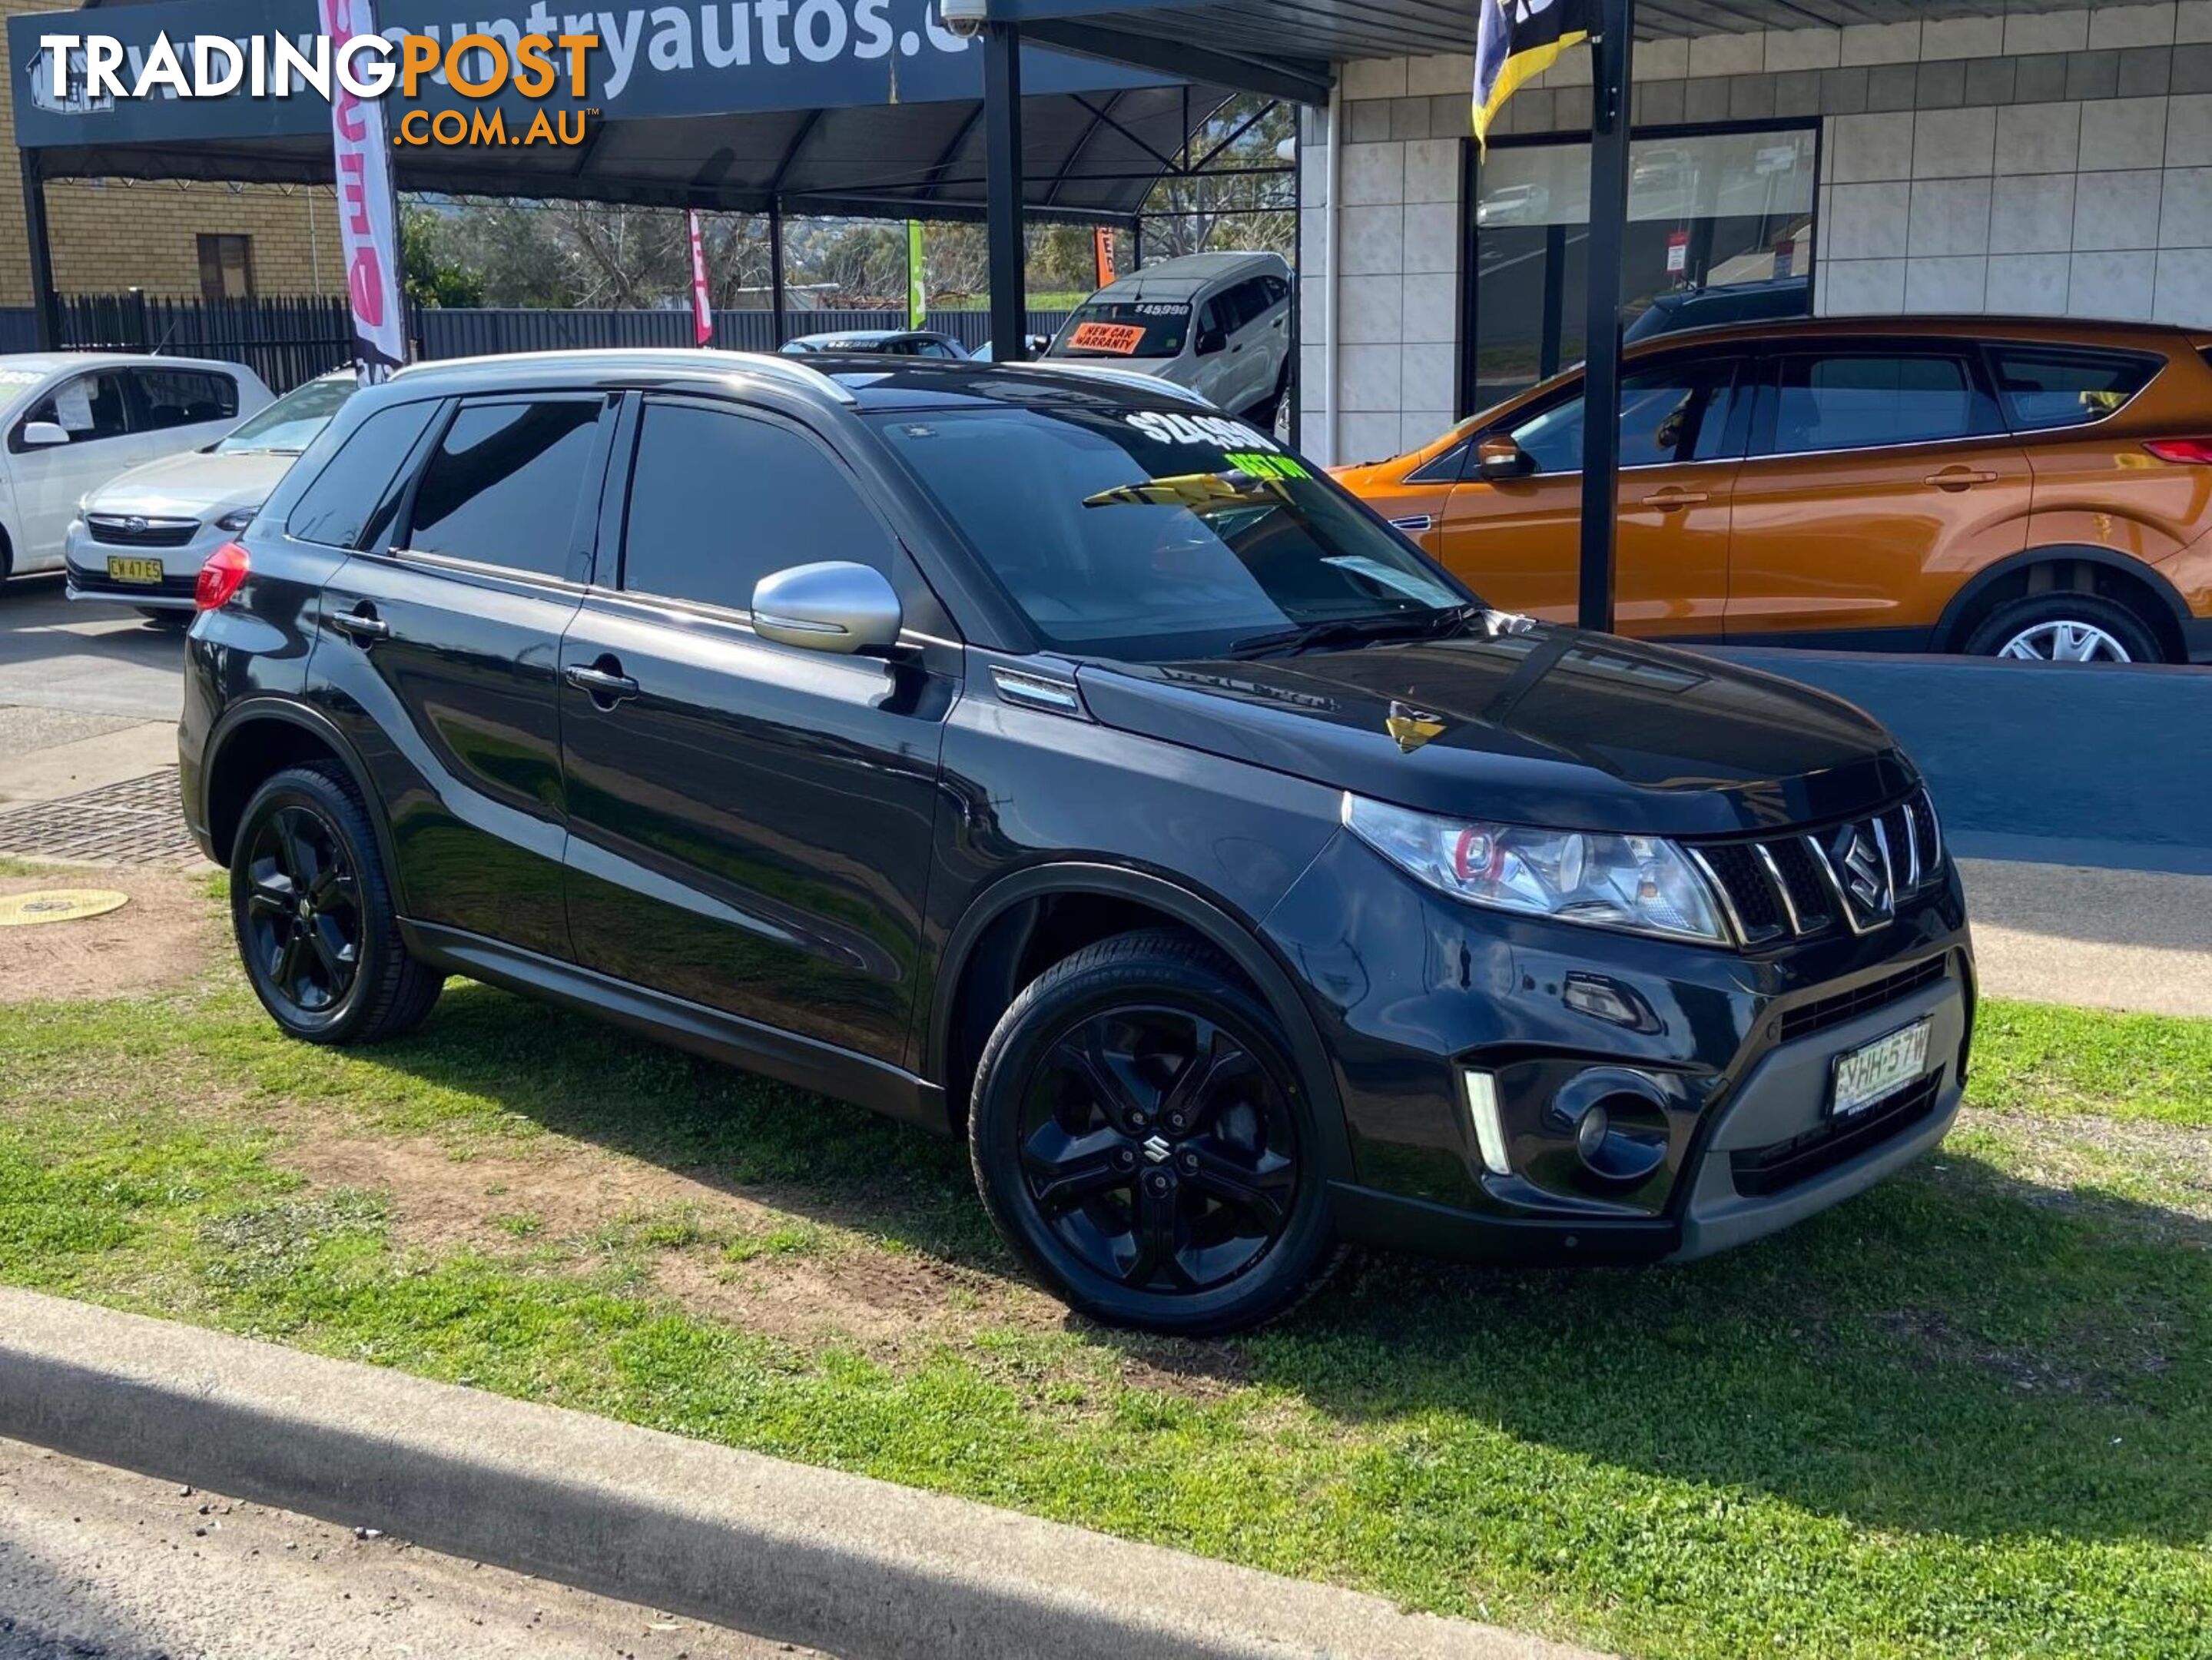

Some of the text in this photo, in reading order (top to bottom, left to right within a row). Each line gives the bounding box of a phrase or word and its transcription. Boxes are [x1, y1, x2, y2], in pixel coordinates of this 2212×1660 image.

[1084, 325, 1133, 339] NEW CAR
[1076, 337, 1133, 350] WARRANTY
